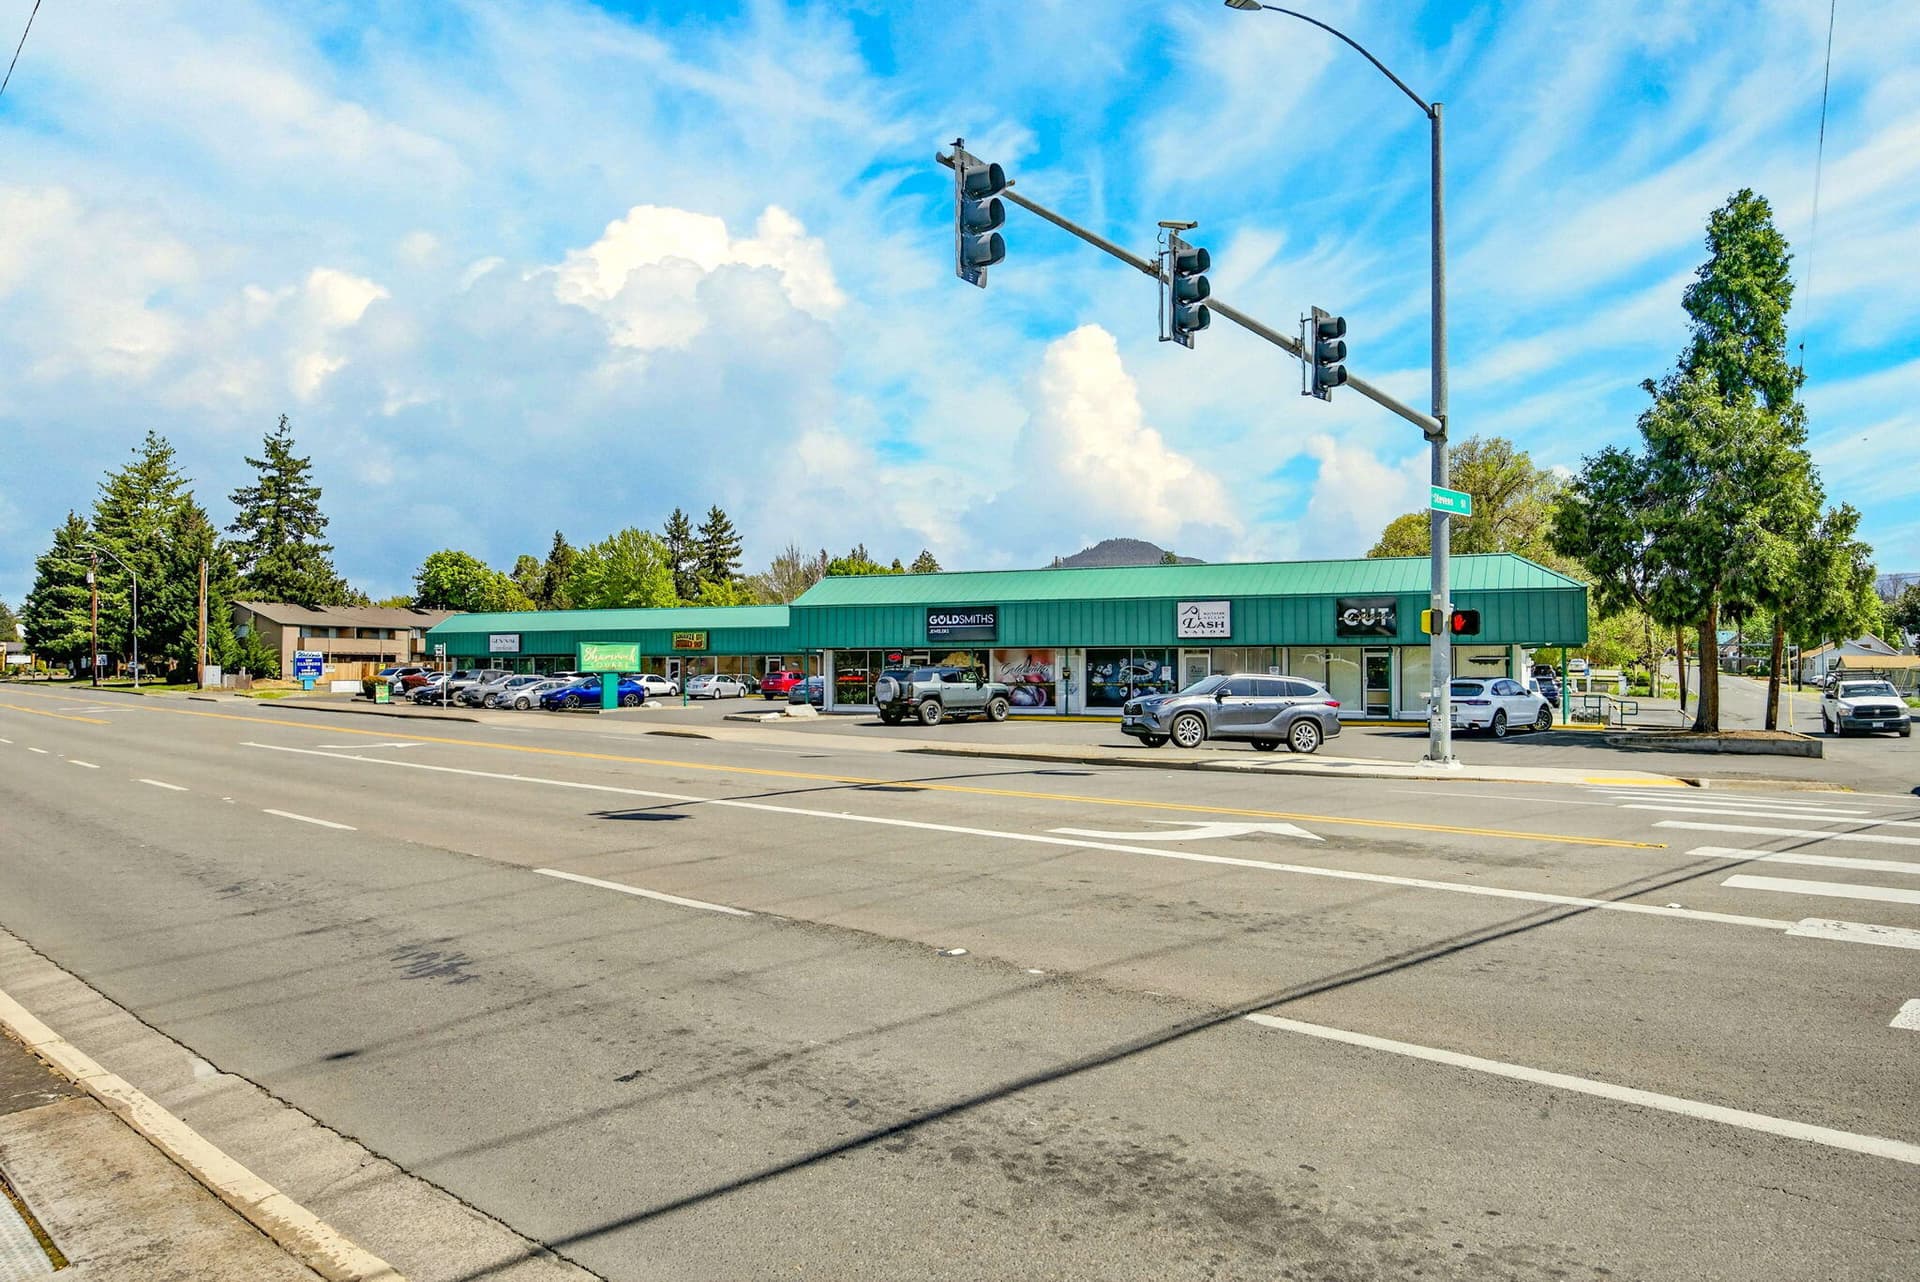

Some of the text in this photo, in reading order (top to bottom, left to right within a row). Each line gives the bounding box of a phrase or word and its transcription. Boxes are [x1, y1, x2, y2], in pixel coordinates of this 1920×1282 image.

[929, 614, 994, 625] GOLDSMITHS
[1343, 607, 1389, 626] CUT
[1182, 617, 1225, 629] LASH
